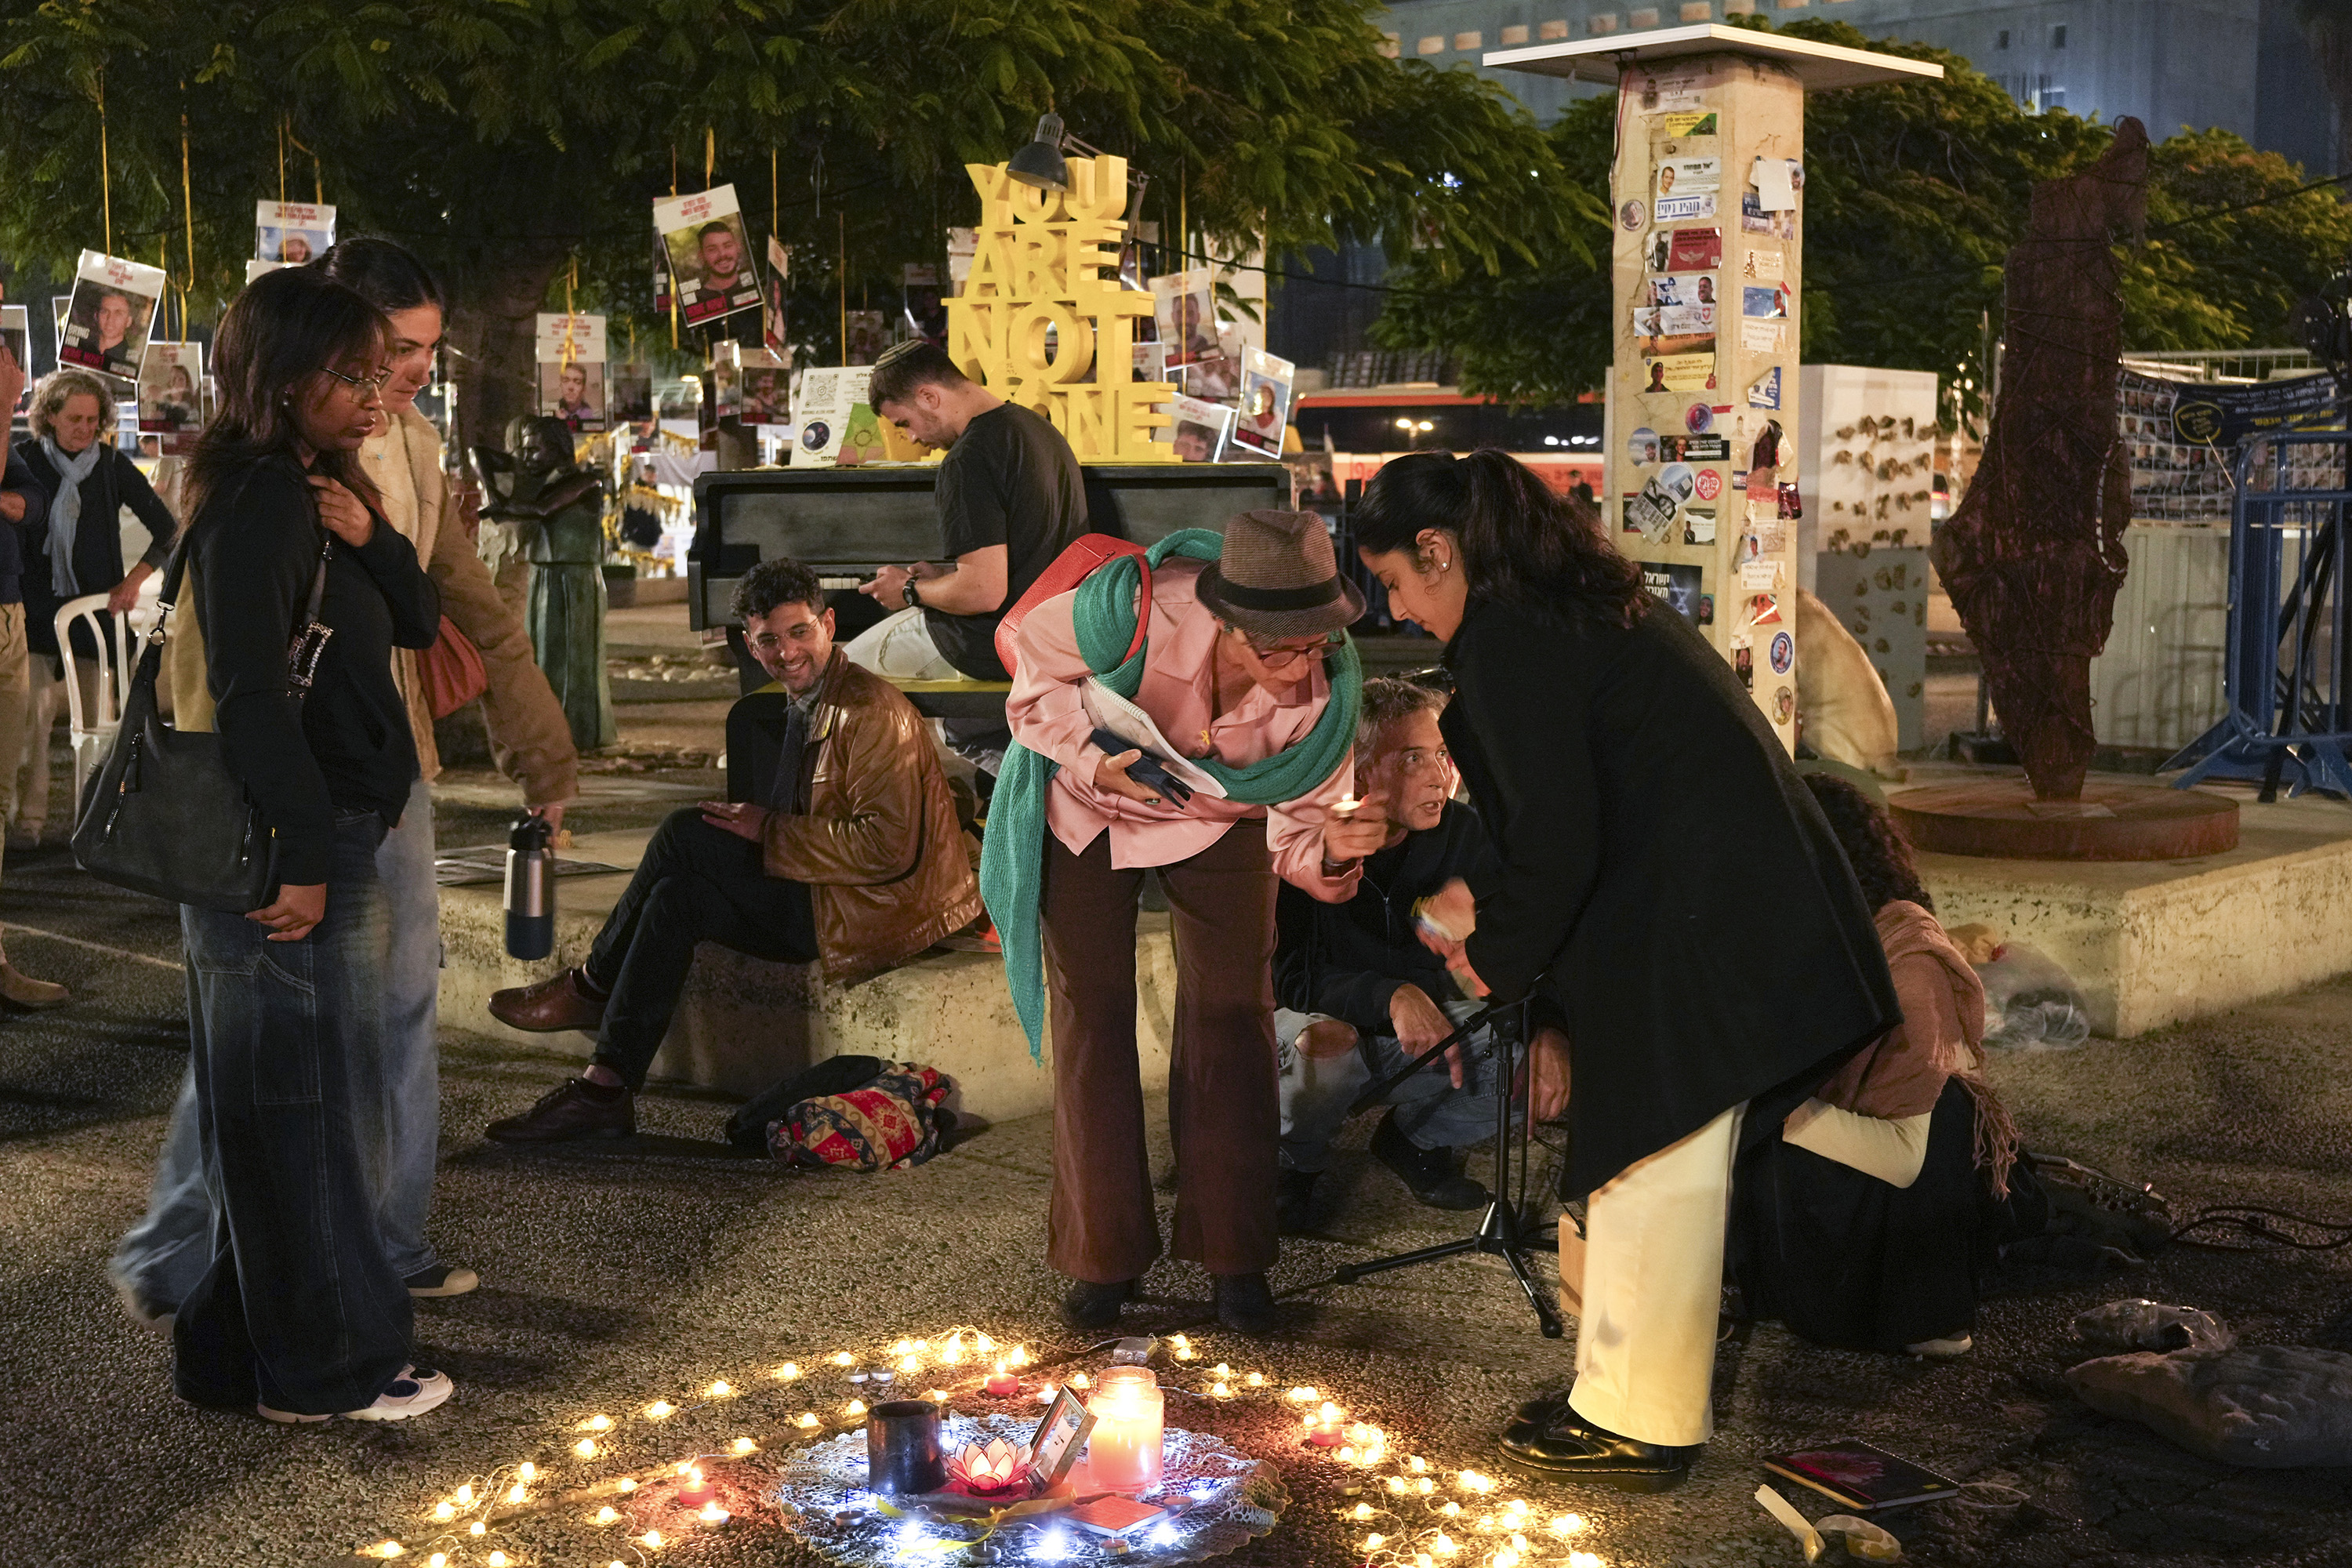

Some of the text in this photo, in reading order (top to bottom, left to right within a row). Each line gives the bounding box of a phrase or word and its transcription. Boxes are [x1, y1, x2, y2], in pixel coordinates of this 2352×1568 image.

[965, 154, 1127, 224] YOU
[963, 220, 1127, 298] ARE
[64, 335, 80, 347] HIM
[67, 323, 90, 339] BRING
[941, 290, 1156, 387] NOT
[1644, 571, 1670, 586] ישראל
